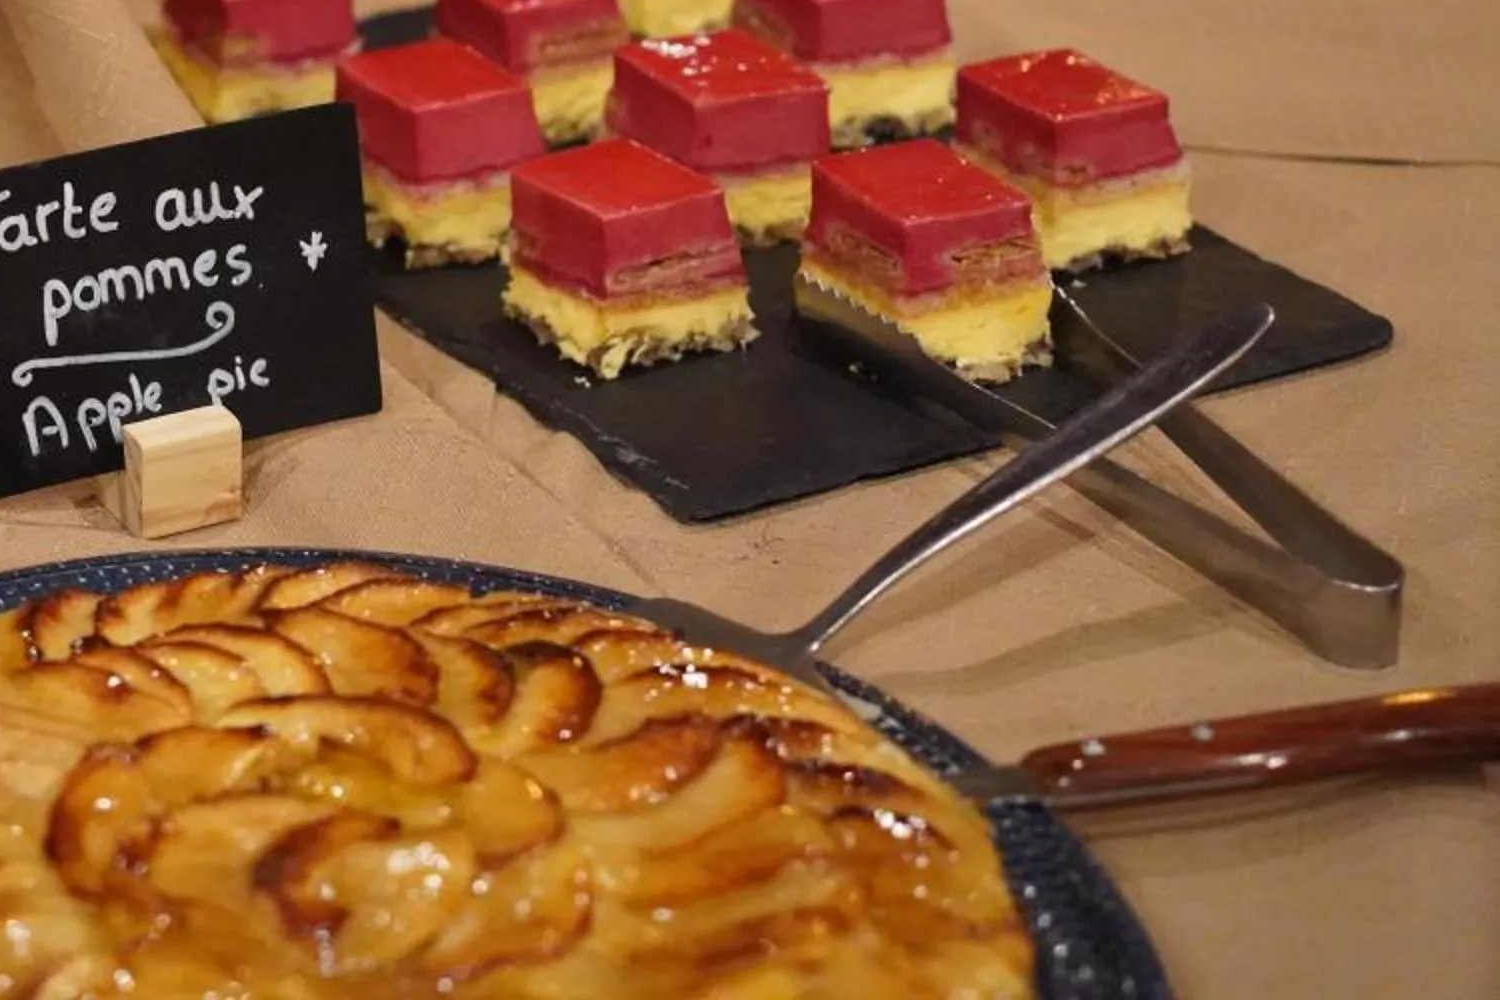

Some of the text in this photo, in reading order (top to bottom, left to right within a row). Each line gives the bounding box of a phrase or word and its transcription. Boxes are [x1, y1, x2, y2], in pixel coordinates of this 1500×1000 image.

[154, 180, 265, 233] aux
[42, 242, 254, 347] pommes
[21, 354, 271, 457] Apple pie
